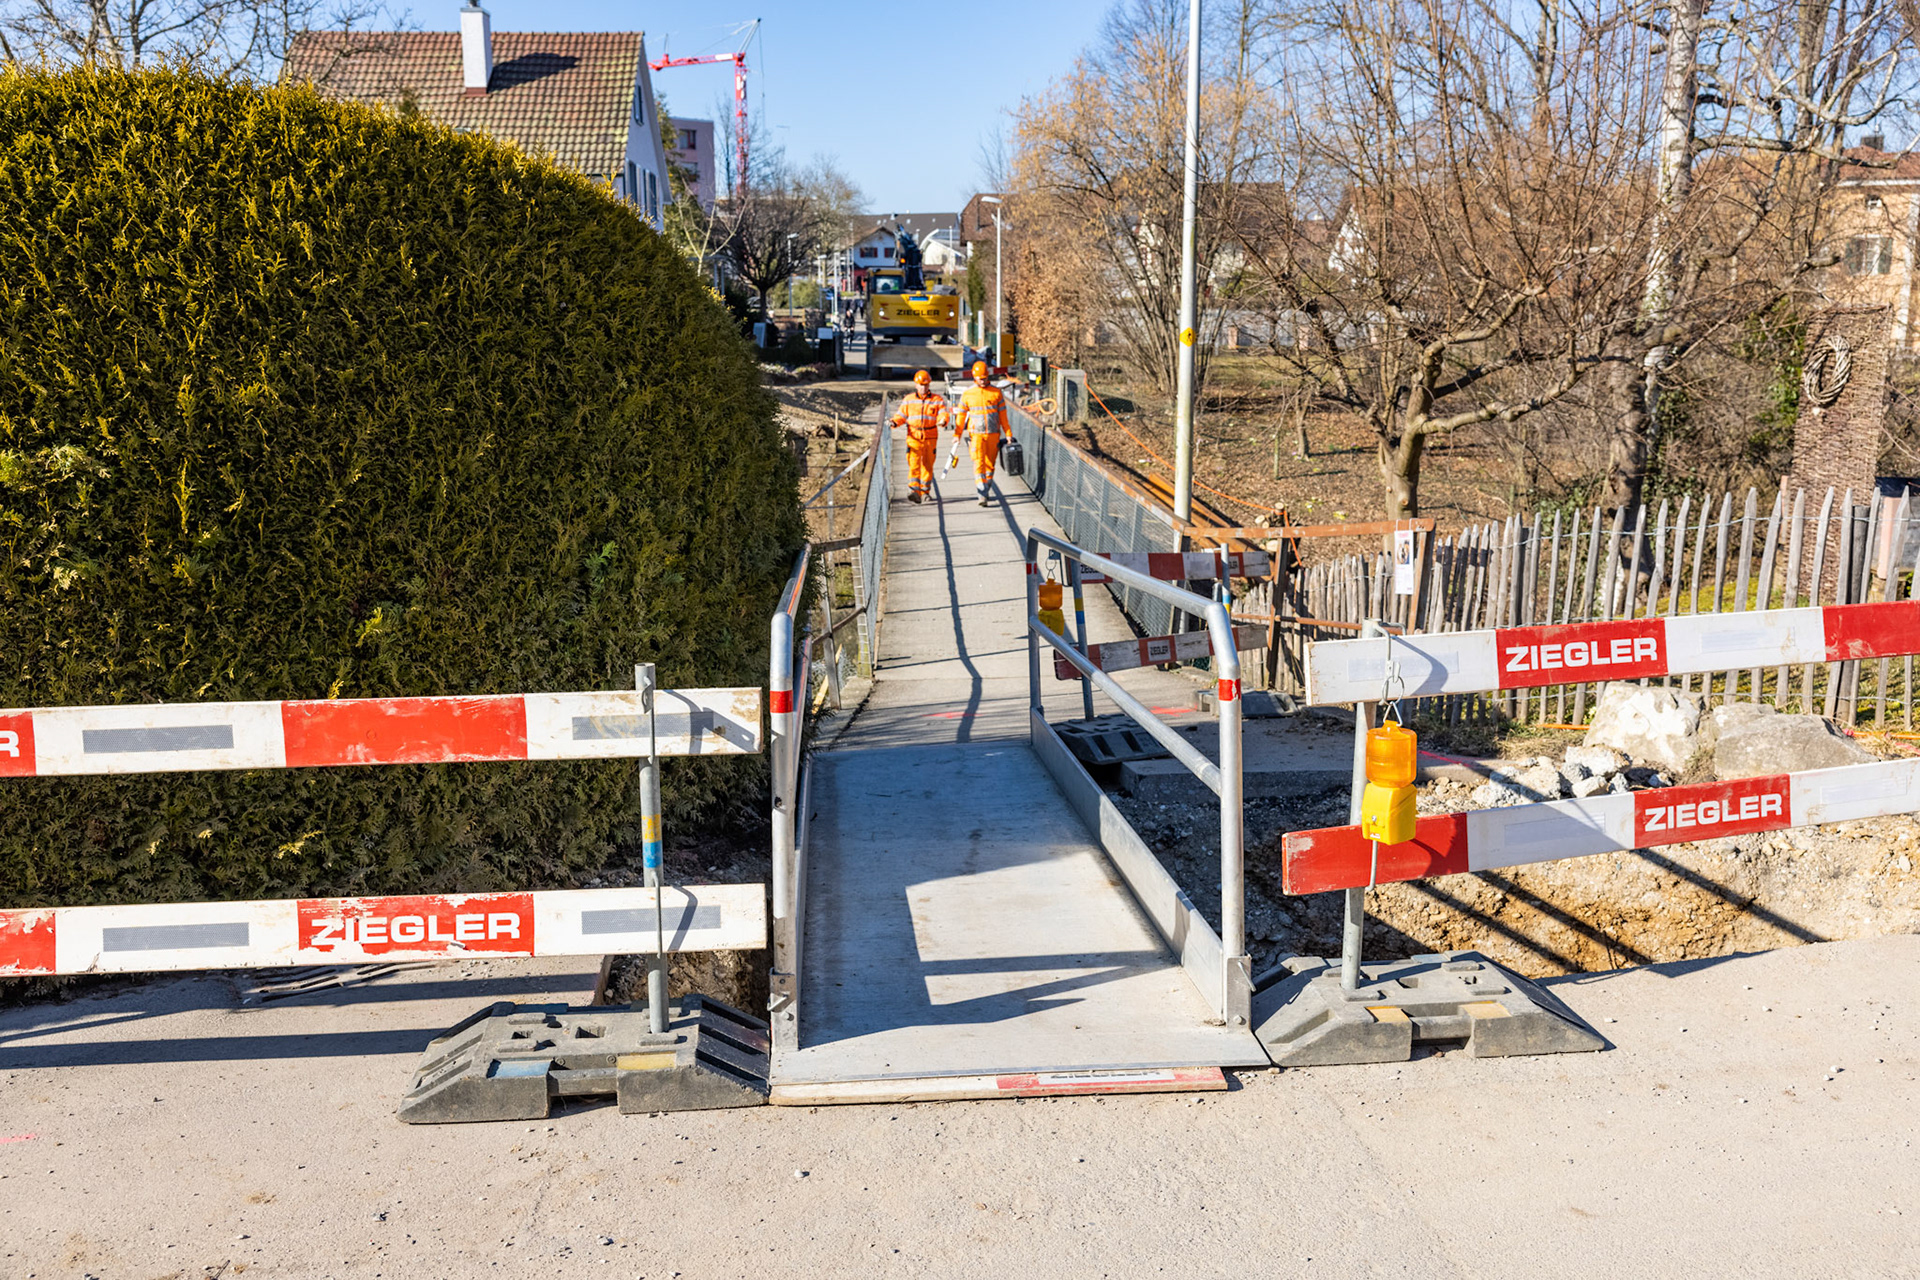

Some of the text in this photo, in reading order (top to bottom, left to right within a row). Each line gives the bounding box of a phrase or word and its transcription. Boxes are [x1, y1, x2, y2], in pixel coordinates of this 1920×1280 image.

[1506, 637, 1658, 672] ZIEGLER
[1644, 793, 1783, 832] ZIEGLER
[310, 912, 520, 947] ZIEGLER
